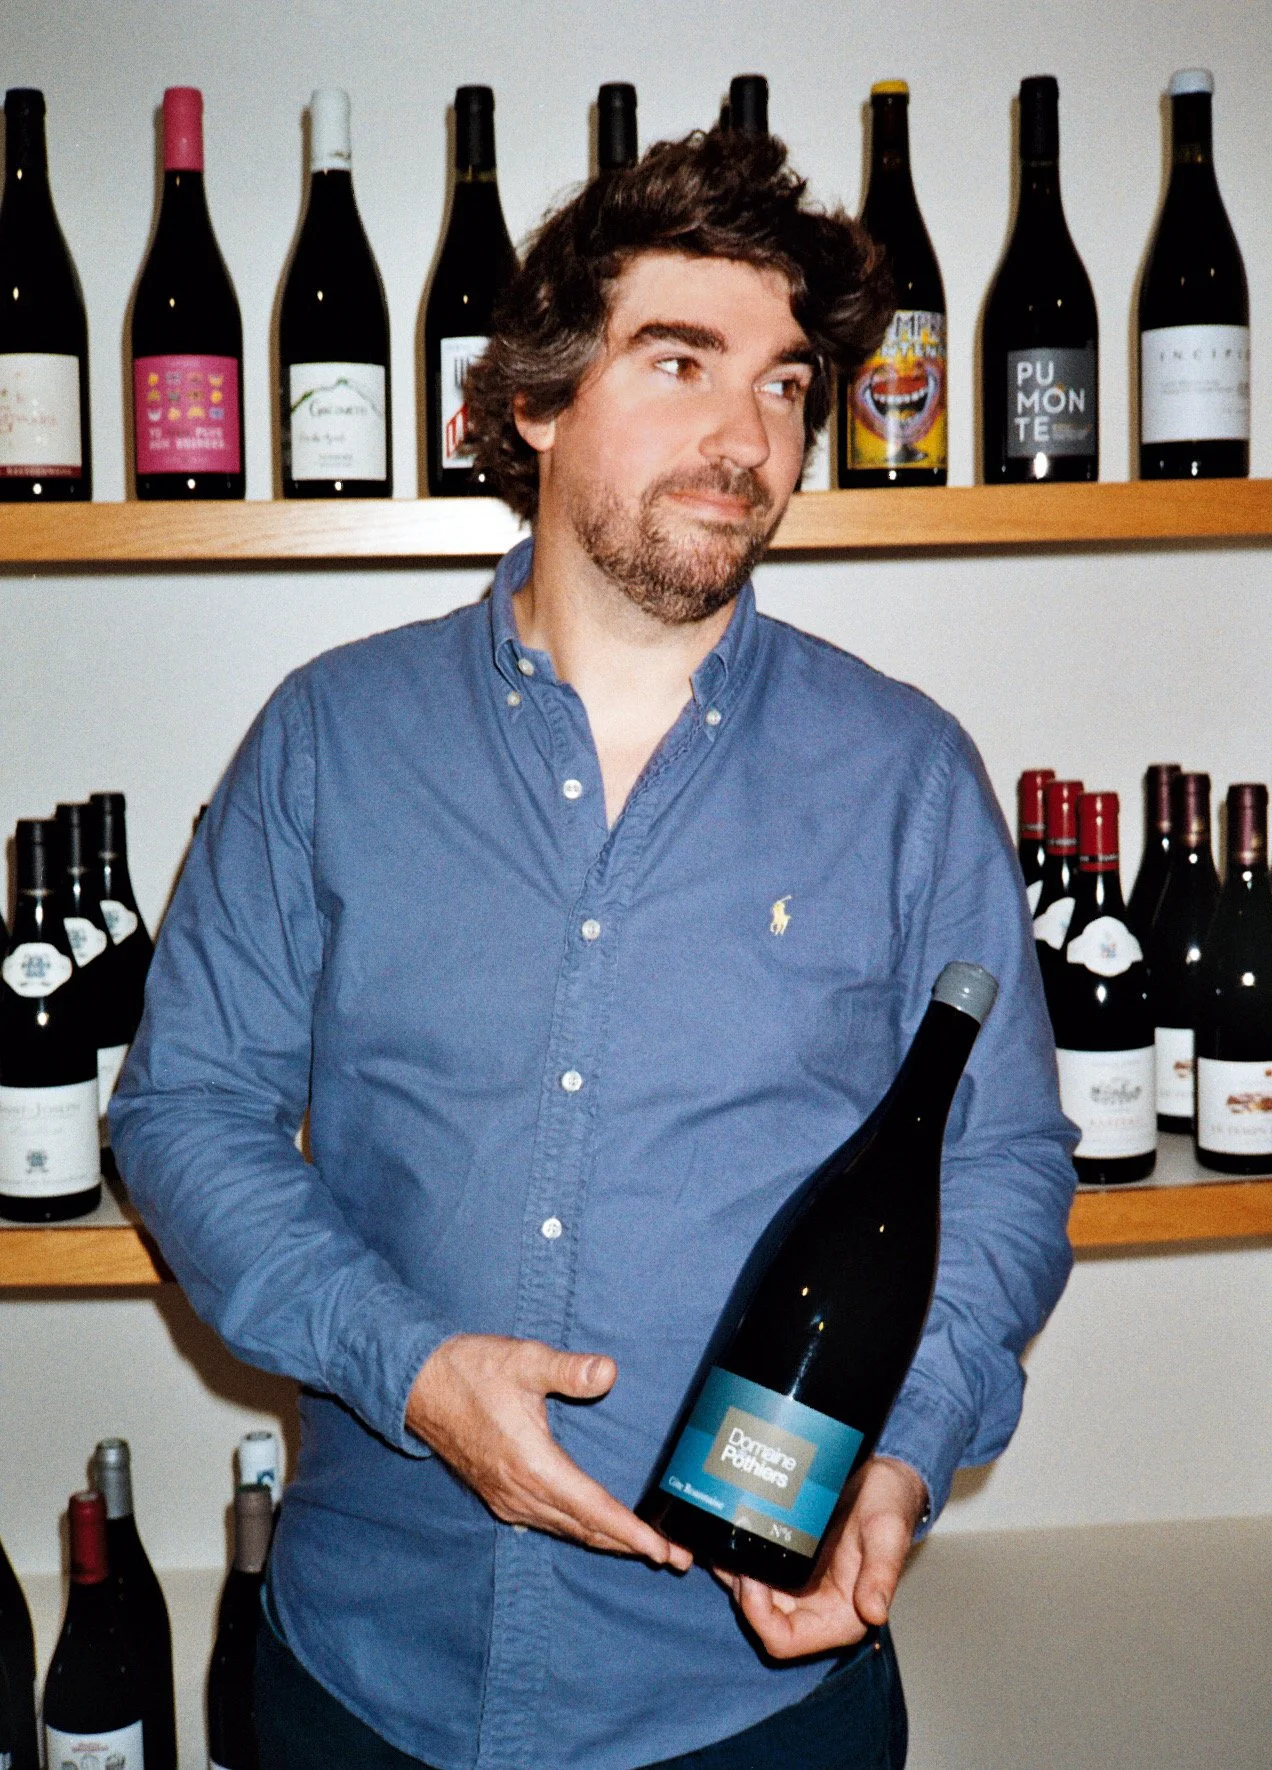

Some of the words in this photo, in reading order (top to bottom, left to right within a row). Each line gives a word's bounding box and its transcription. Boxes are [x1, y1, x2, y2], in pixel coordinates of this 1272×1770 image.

[1017, 360, 1055, 388] PU
[1017, 387, 1086, 415] MON
[1014, 415, 1051, 442] TE
[729, 1427, 798, 1472] Domaine
[721, 1444, 789, 1488] Pothiers
